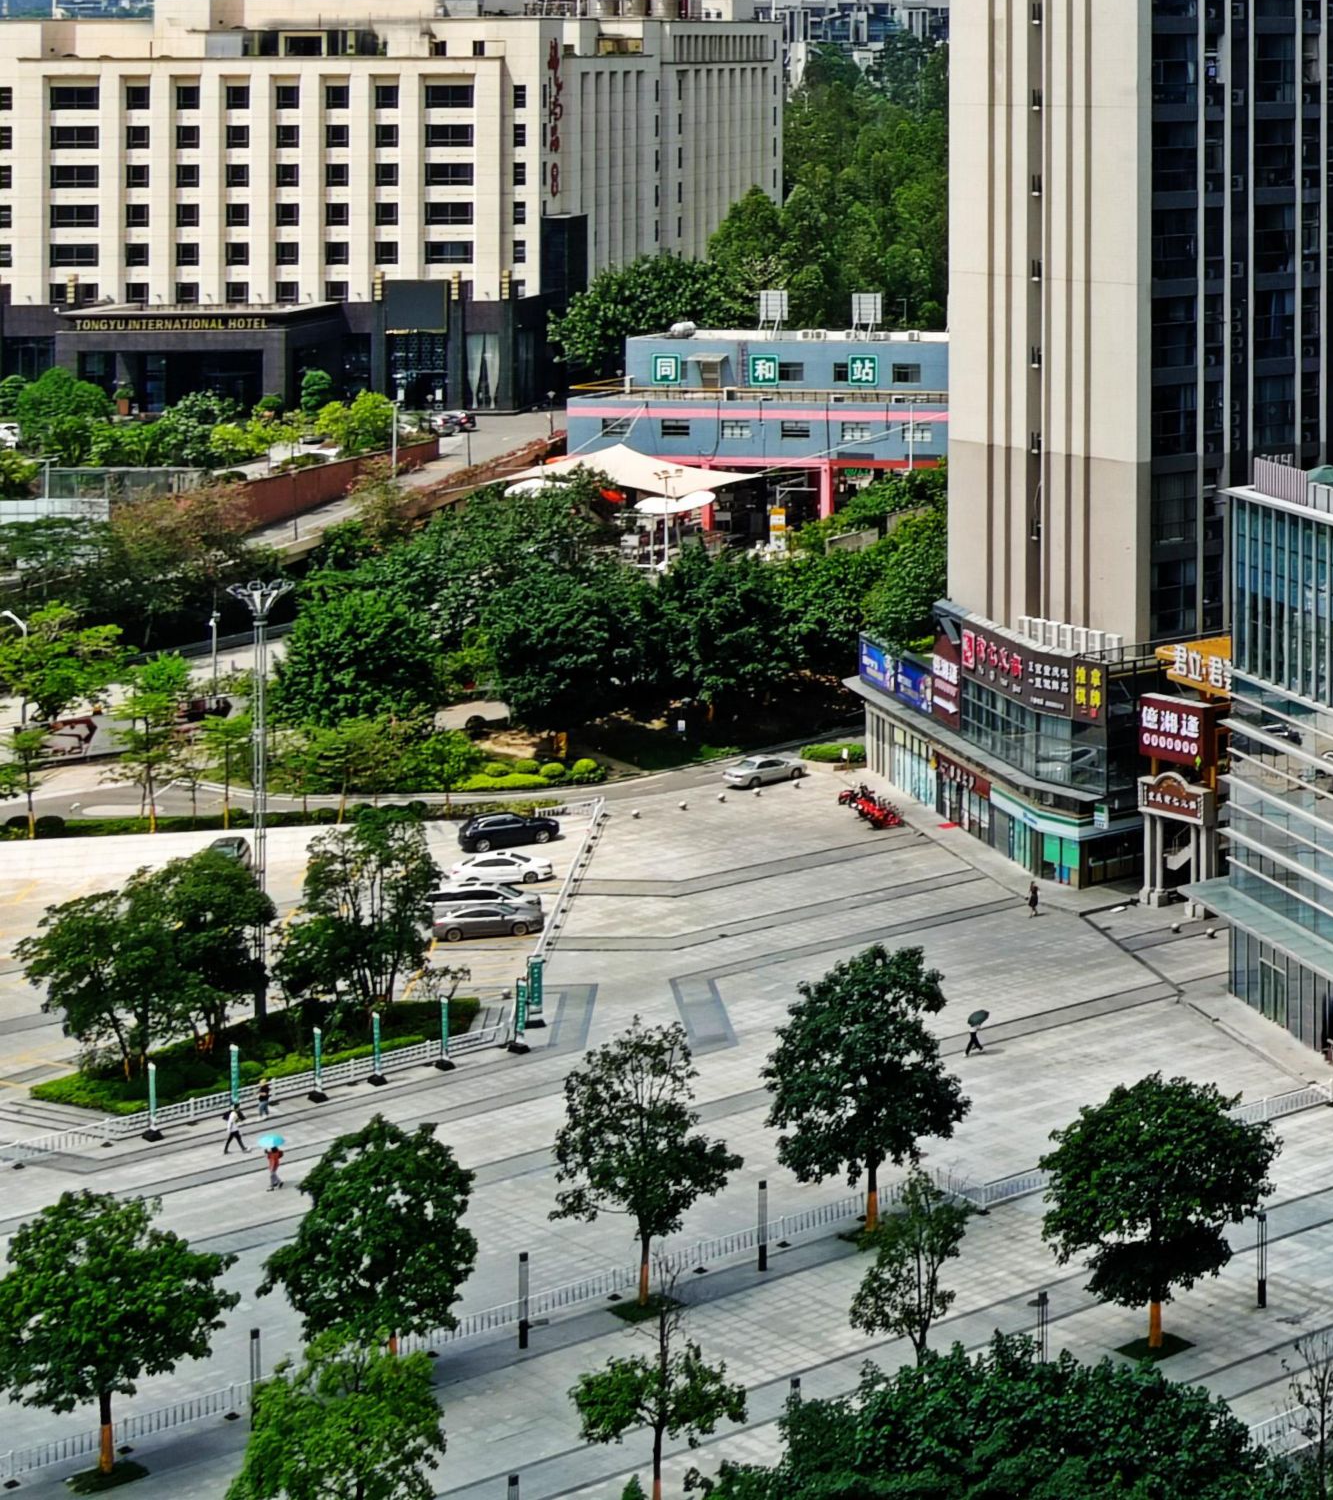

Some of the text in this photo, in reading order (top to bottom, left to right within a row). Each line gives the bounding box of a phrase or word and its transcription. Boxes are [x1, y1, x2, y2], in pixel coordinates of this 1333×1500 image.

[76, 318, 268, 330] TONGYU INTERNATIONAL HOTEL
